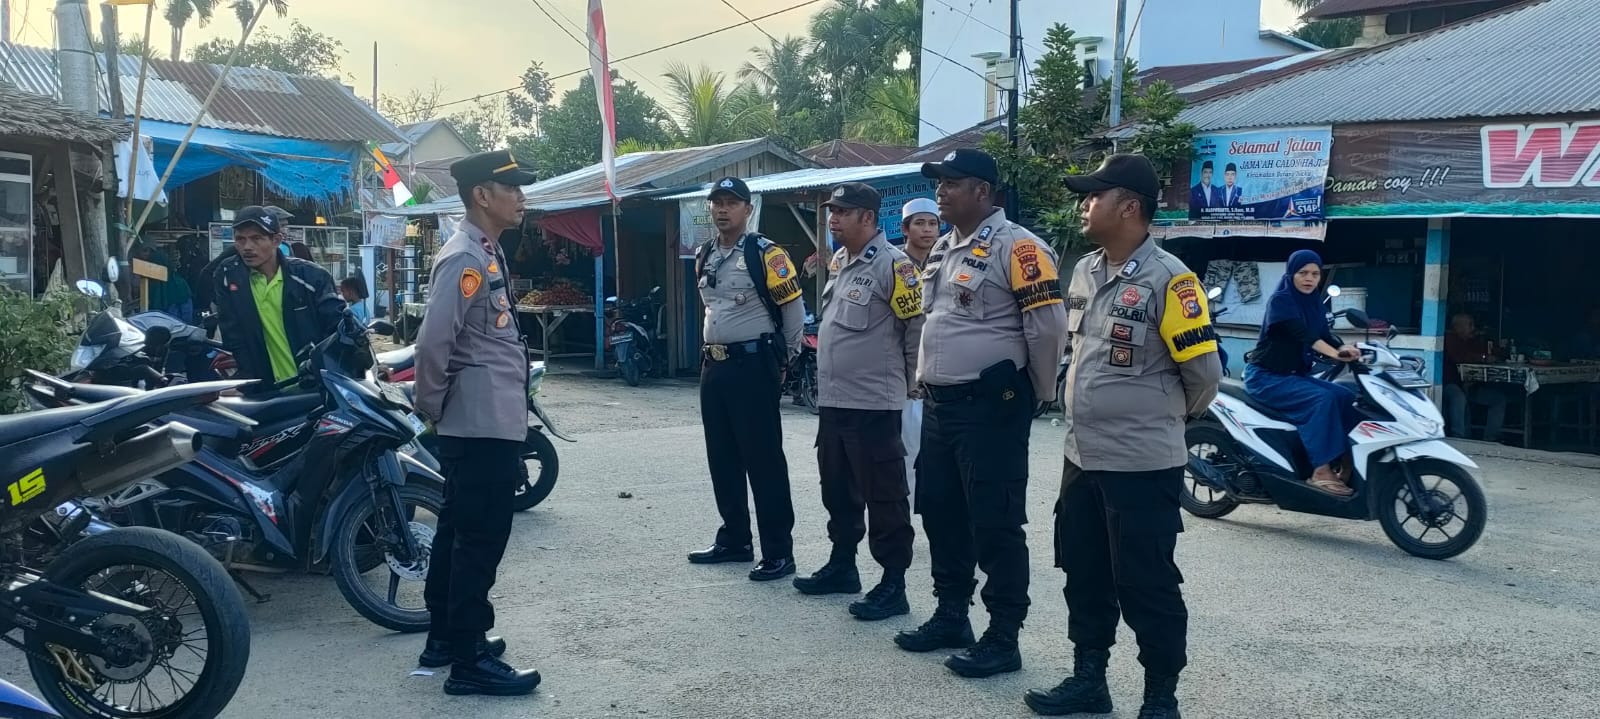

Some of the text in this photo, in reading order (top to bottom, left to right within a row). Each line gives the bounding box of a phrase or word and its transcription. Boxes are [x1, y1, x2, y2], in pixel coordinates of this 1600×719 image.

[1228, 137, 1322, 156] Selamat Jalan
[1481, 121, 1600, 188] W
[1276, 159, 1301, 168] CALON
[1383, 176, 1412, 195] coy
[961, 257, 987, 272] POLRI
[851, 276, 872, 287] POLRI
[1111, 306, 1144, 321] POLRI
[7, 467, 47, 506] 15
